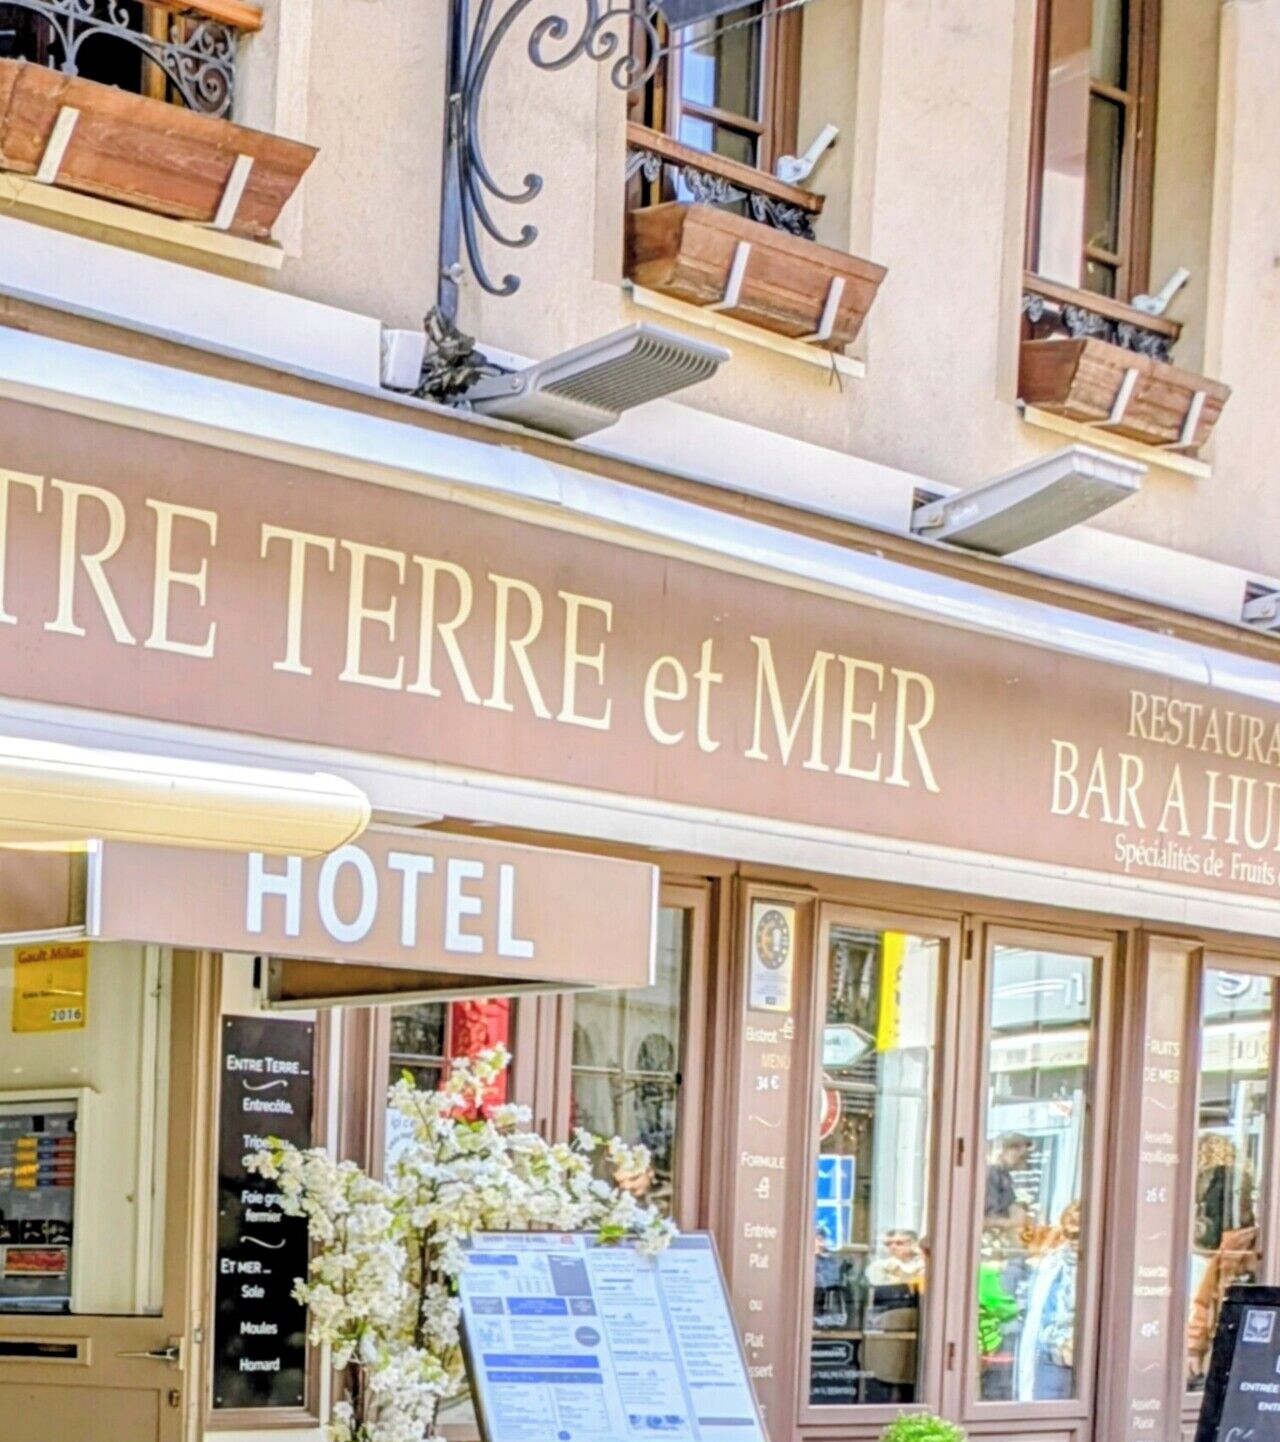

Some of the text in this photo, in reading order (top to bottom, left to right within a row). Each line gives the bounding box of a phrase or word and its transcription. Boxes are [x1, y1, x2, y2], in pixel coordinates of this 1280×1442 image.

[261, 523, 612, 731] TERRE
[643, 638, 723, 754] et
[744, 634, 940, 793] MER
[1050, 738, 1146, 829] BAR
[1157, 763, 1191, 837] A
[1114, 833, 1200, 873] Spécialités
[1203, 848, 1224, 877] de
[1229, 852, 1275, 886] Fruits
[246, 844, 534, 958] HOTEL
[51, 1009, 82, 1021] 2016
[745, 1026, 778, 1043] Bistrot
[1145, 1036, 1180, 1057] FRUITS
[226, 1054, 300, 1074] ENTRE TERRE
[741, 1151, 785, 1170] FORMULE
[241, 1190, 263, 1204] Foie
[245, 1208, 282, 1222] fermier
[744, 1222, 777, 1239] Entrée
[749, 1253, 769, 1269] Plat
[241, 1284, 266, 1298] Sole
[240, 1321, 278, 1335] Moules
[745, 1332, 764, 1348] Plat
[239, 1357, 281, 1371] Homard
